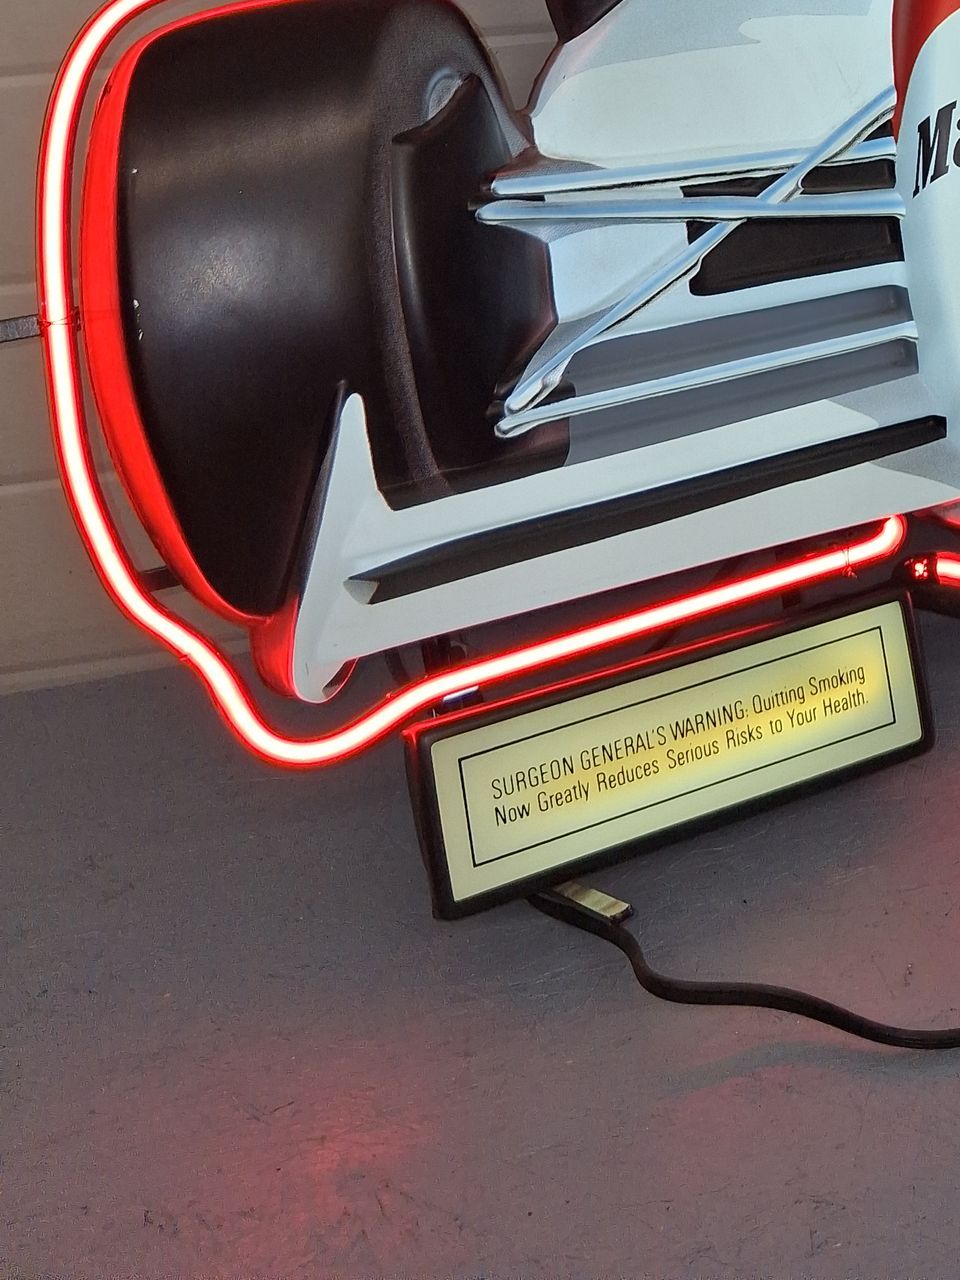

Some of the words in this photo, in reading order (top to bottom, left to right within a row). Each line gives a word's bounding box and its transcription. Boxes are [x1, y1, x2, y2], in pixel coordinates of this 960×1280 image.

[491, 755, 575, 800] SURGEON
[580, 725, 667, 771] GENERAL'S
[669, 700, 749, 741] WARNING:
[752, 684, 806, 714] Quitting
[808, 666, 866, 696] Smoking
[494, 802, 531, 827] Now
[537, 780, 590, 812] Greatly
[596, 759, 660, 793] Reduces
[666, 740, 720, 769] Serious
[726, 724, 763, 750] Risks
[769, 718, 783, 735] to
[786, 707, 817, 729] Your
[822, 688, 869, 718] Health.
